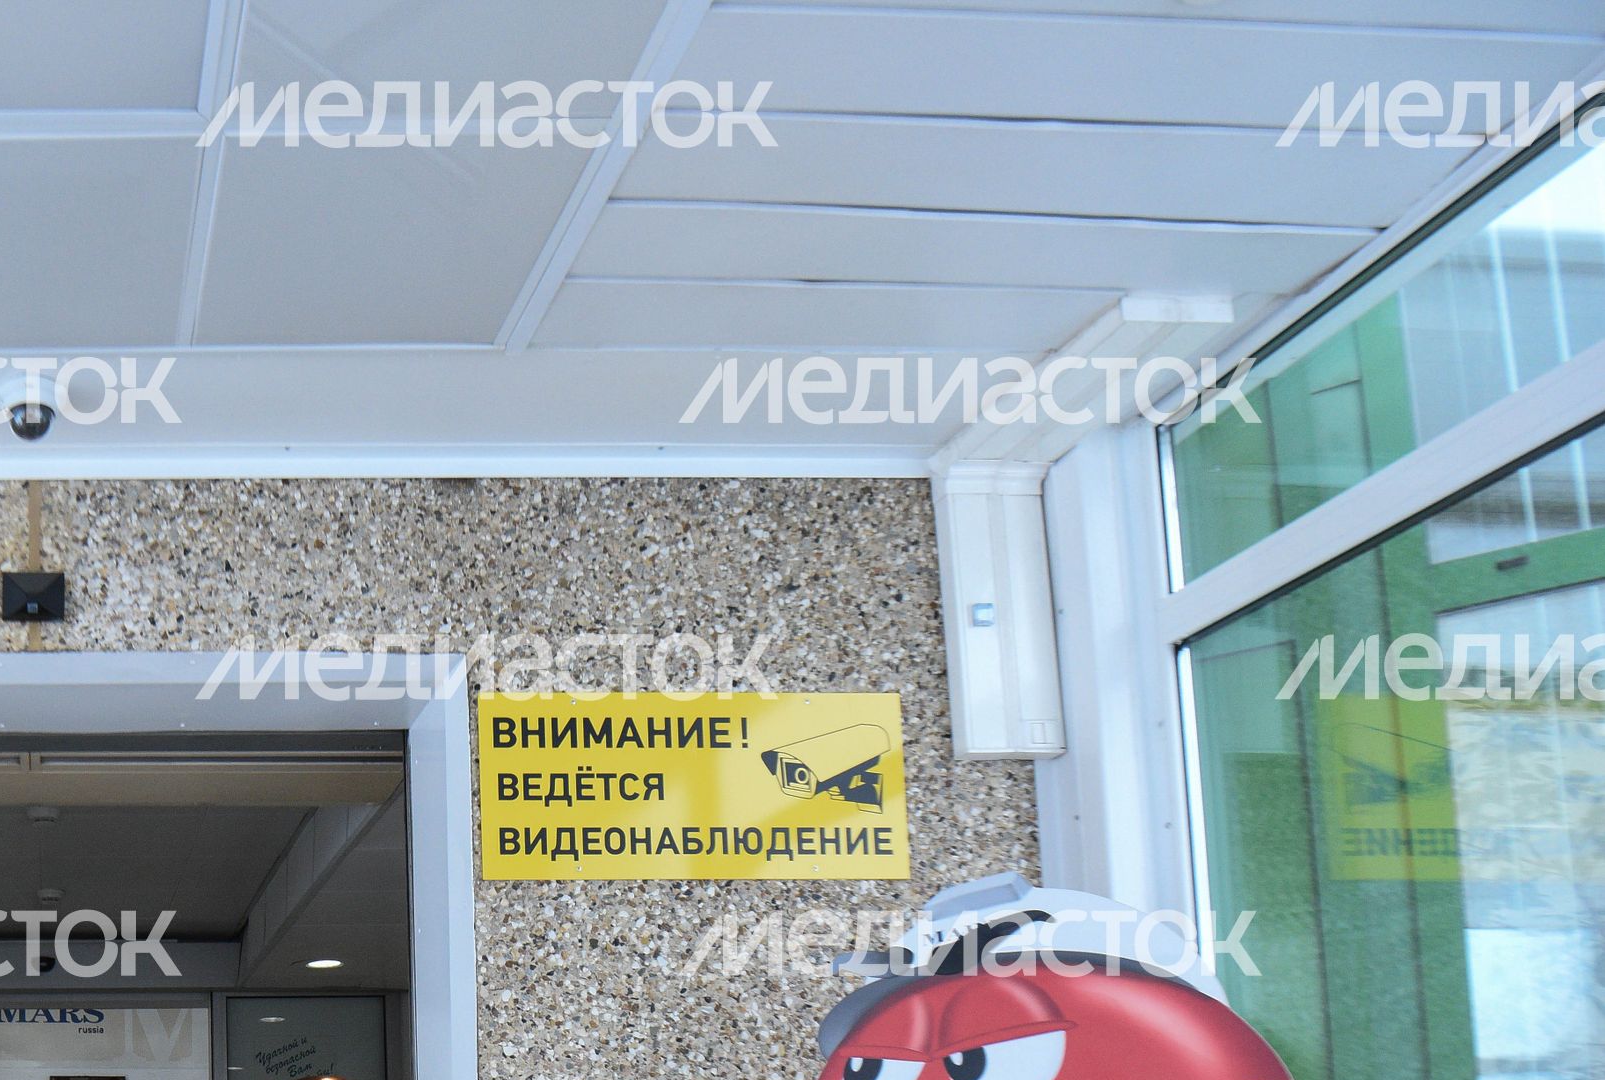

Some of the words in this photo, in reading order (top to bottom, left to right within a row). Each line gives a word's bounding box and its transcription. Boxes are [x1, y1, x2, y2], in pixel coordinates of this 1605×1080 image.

[492, 716, 750, 750] ВНИМАНИЕ!
[497, 766, 666, 807] ВЕДЁТСЯ
[499, 827, 894, 861] ВИДЕОНАБЛЮДЕНИЕ
[78, 1025, 105, 1035] russia
